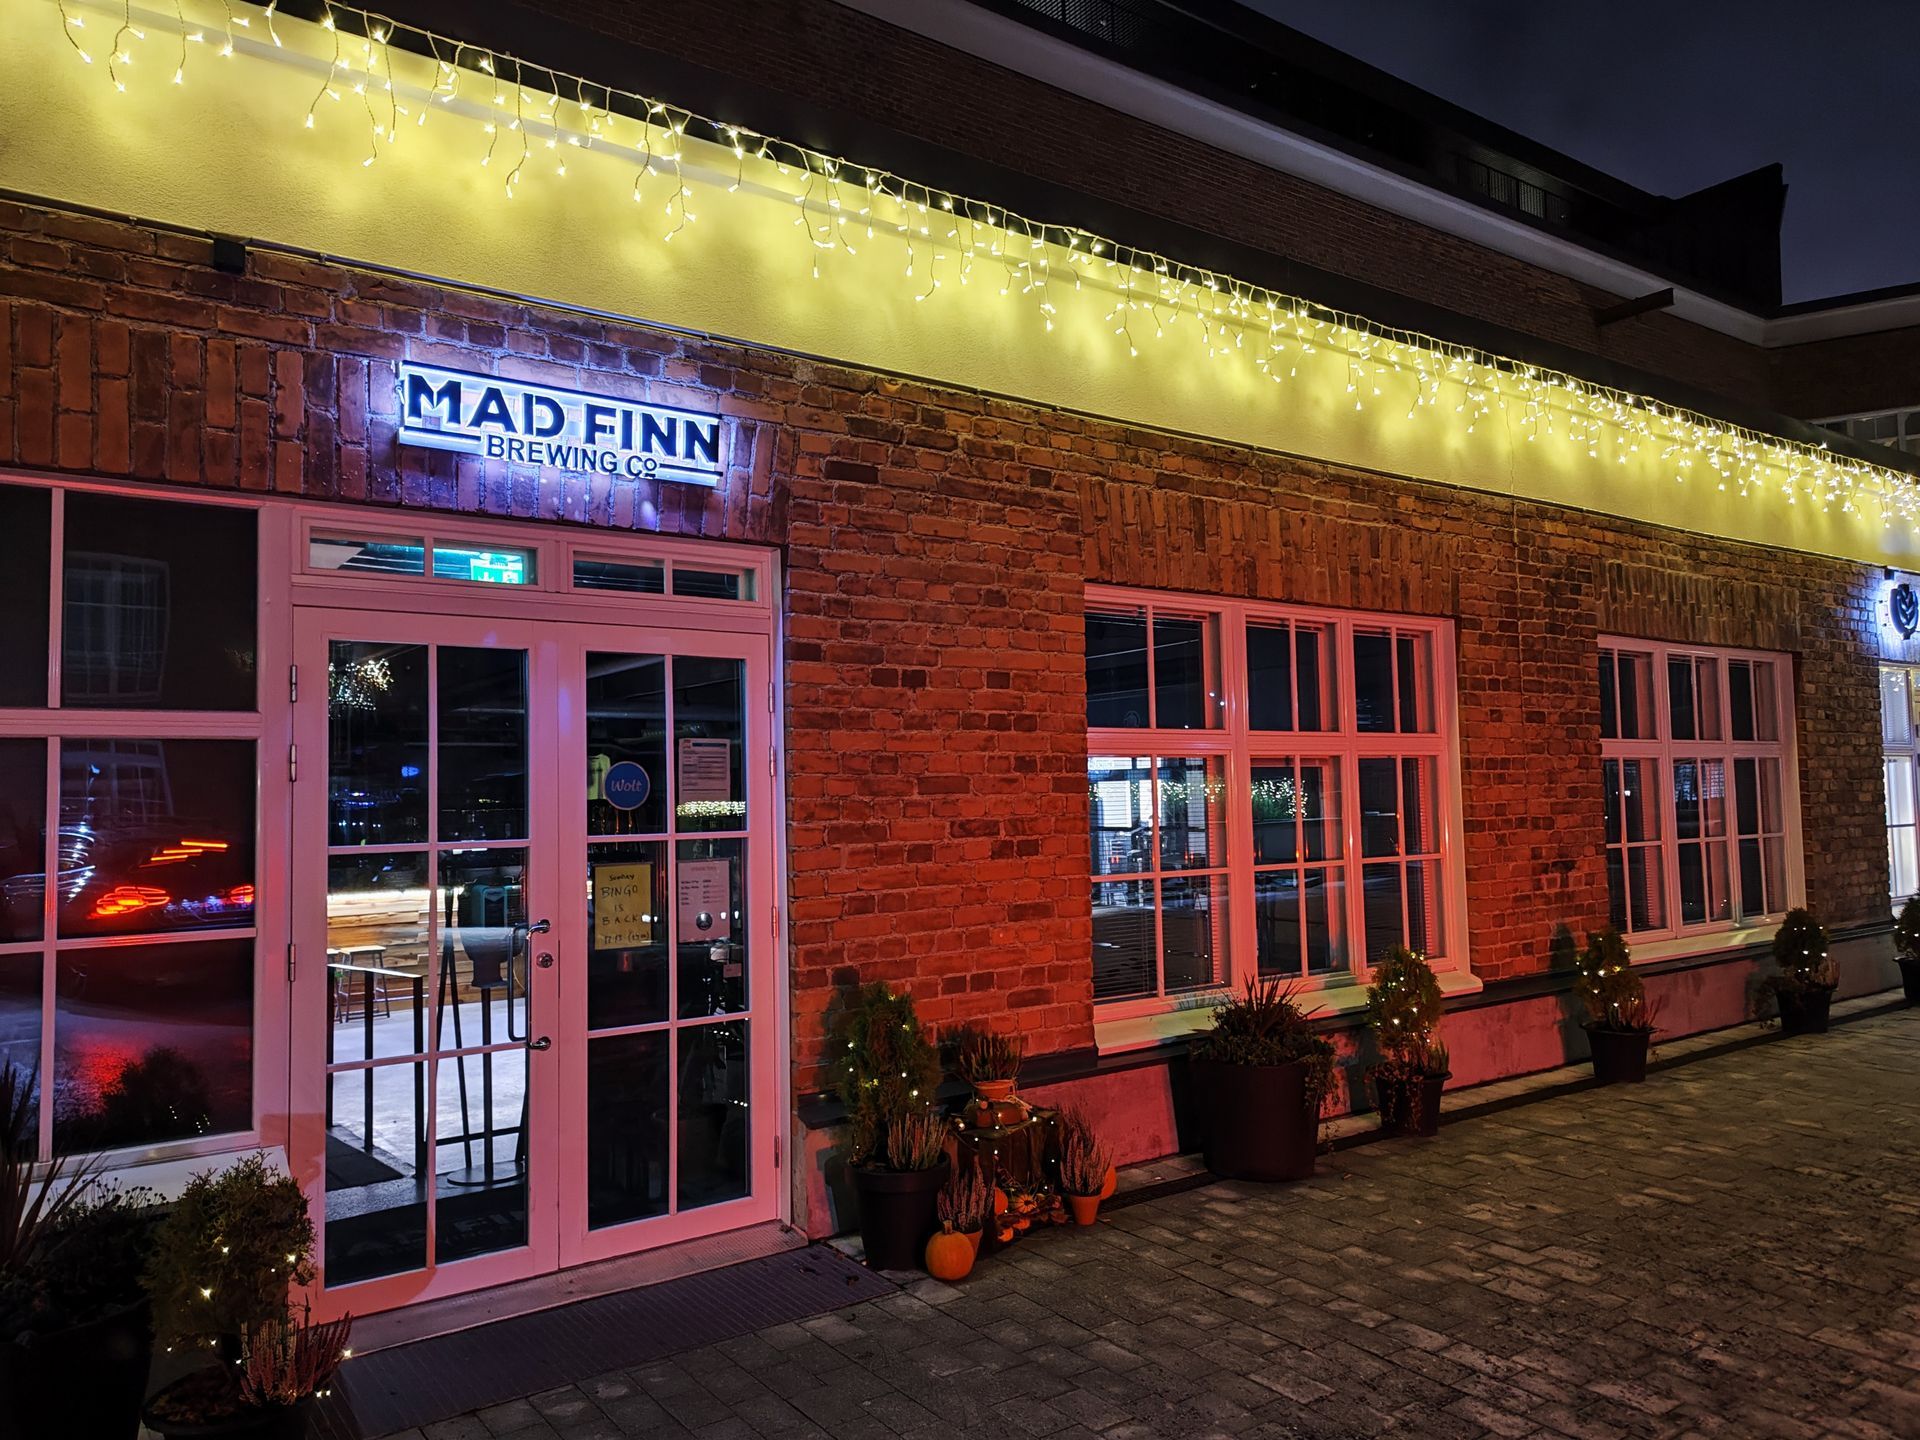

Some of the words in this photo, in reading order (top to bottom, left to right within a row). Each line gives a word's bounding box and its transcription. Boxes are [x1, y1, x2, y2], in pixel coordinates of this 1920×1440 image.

[406, 373, 566, 438] MAD
[583, 402, 719, 463] FINN
[486, 434, 617, 474] BREWING
[610, 779, 642, 792] Wolt
[601, 884, 638, 898] BINGO
[602, 914, 639, 925] BACK
